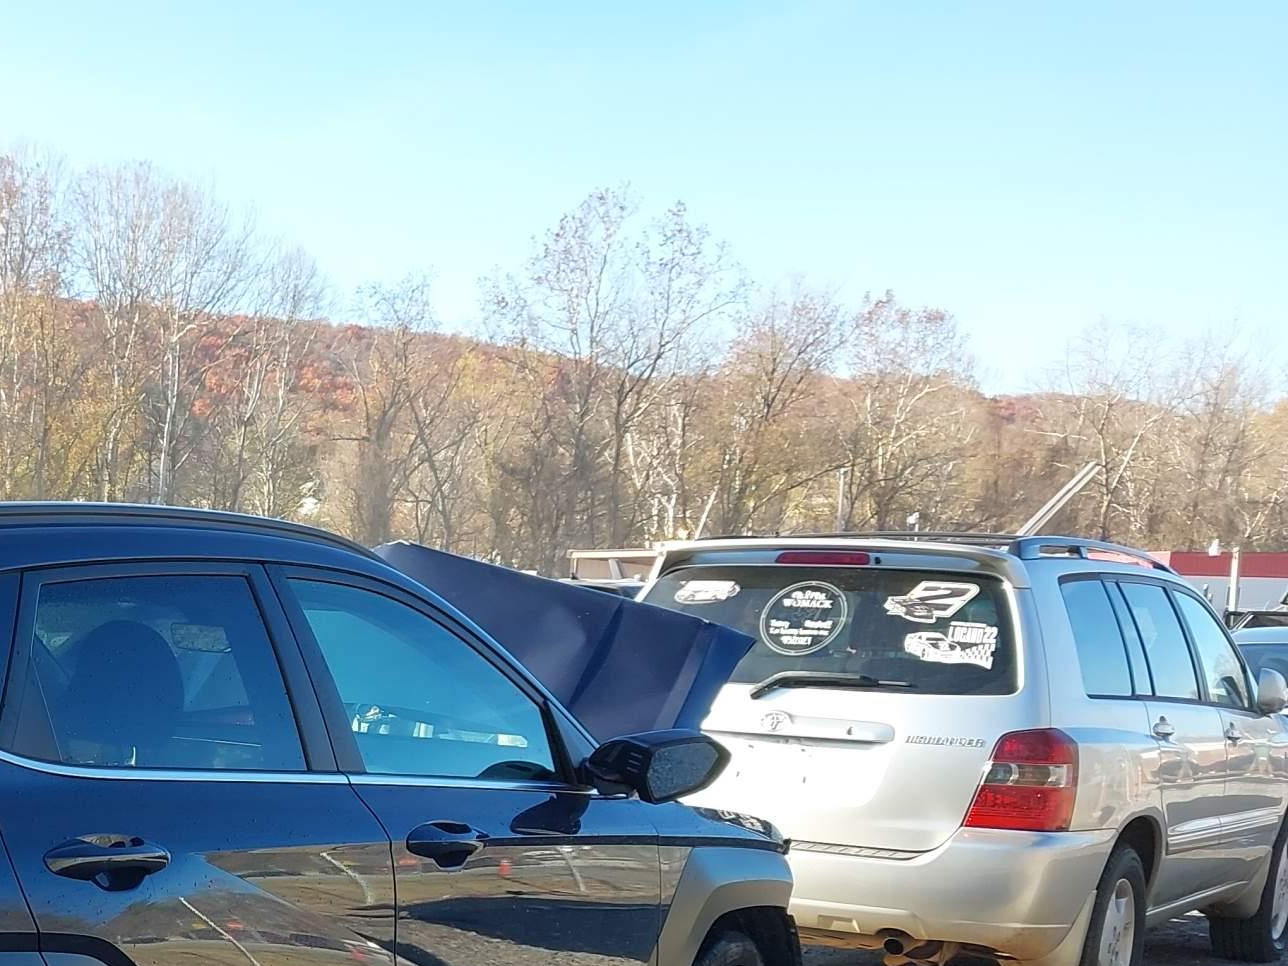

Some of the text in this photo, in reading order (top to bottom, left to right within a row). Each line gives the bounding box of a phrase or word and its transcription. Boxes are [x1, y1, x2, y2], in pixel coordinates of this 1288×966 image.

[947, 626, 998, 643] LOGANO 22
[905, 735, 985, 748] HIGHLANDER
